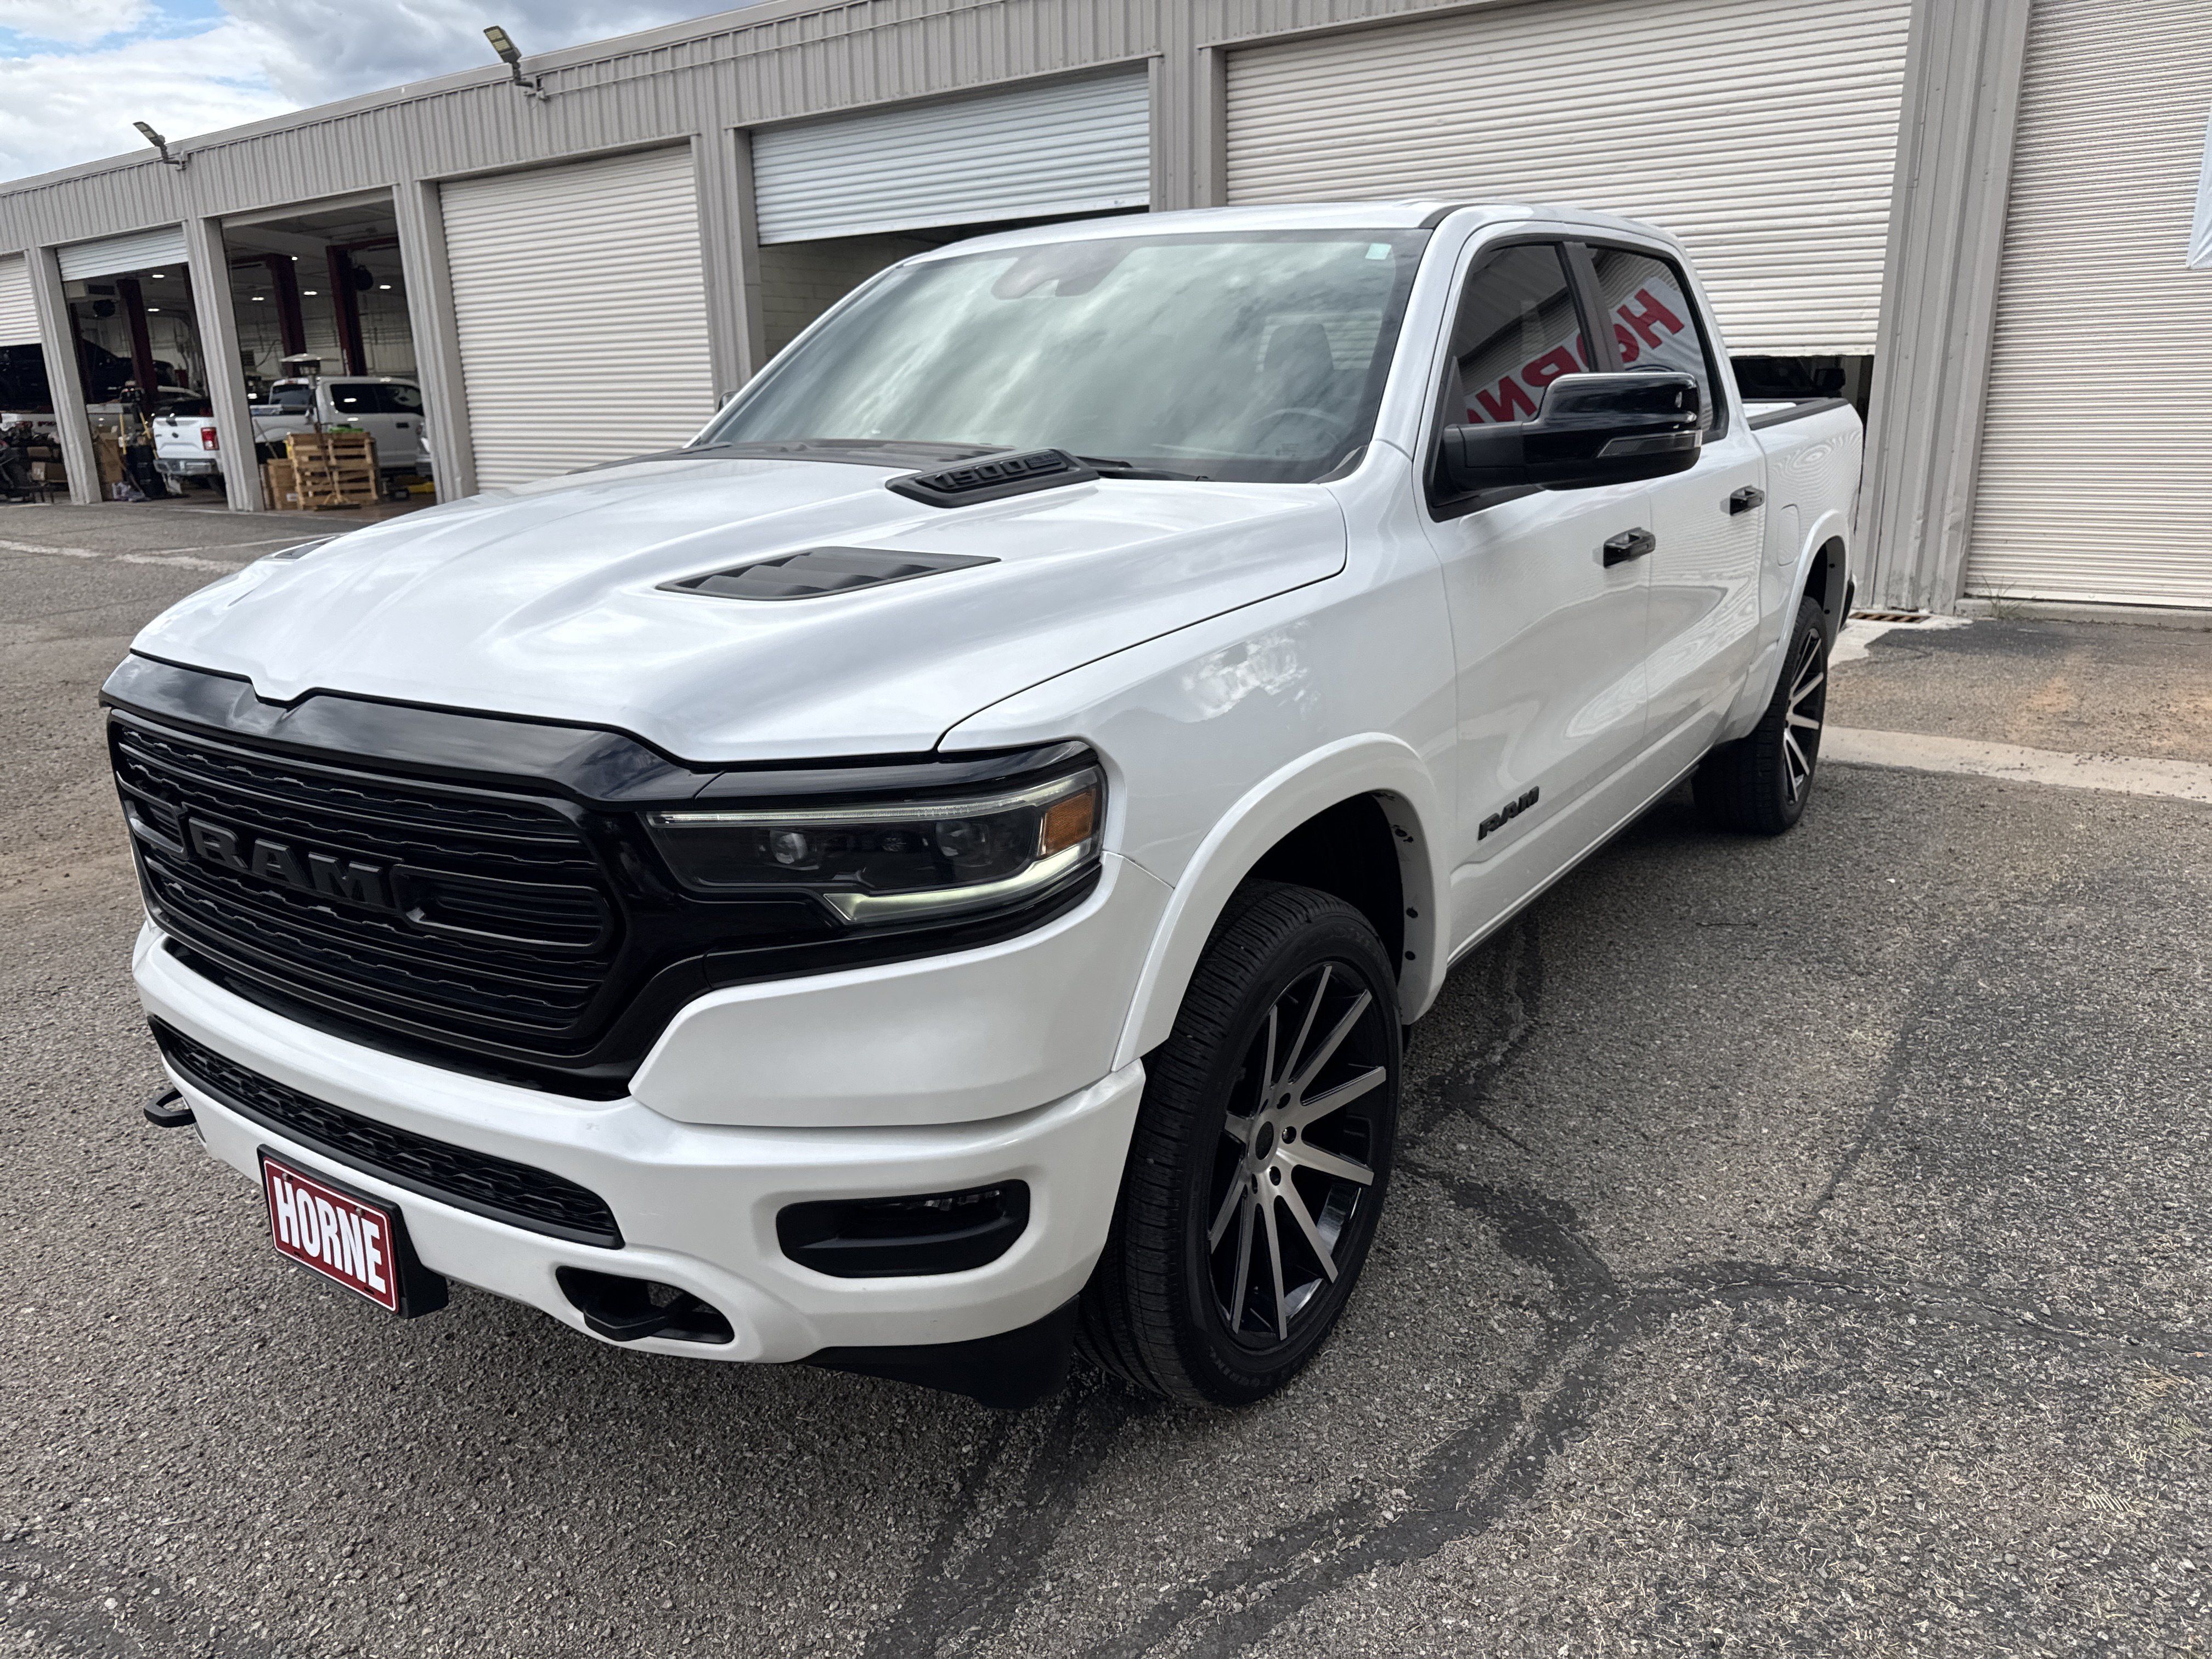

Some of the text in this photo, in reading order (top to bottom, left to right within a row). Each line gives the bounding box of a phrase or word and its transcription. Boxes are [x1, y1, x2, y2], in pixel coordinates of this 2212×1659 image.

[935, 460, 1025, 488] 1500
[1477, 786, 1540, 840] RAM
[188, 816, 386, 906] RAM
[273, 1176, 386, 1294] HORNE
